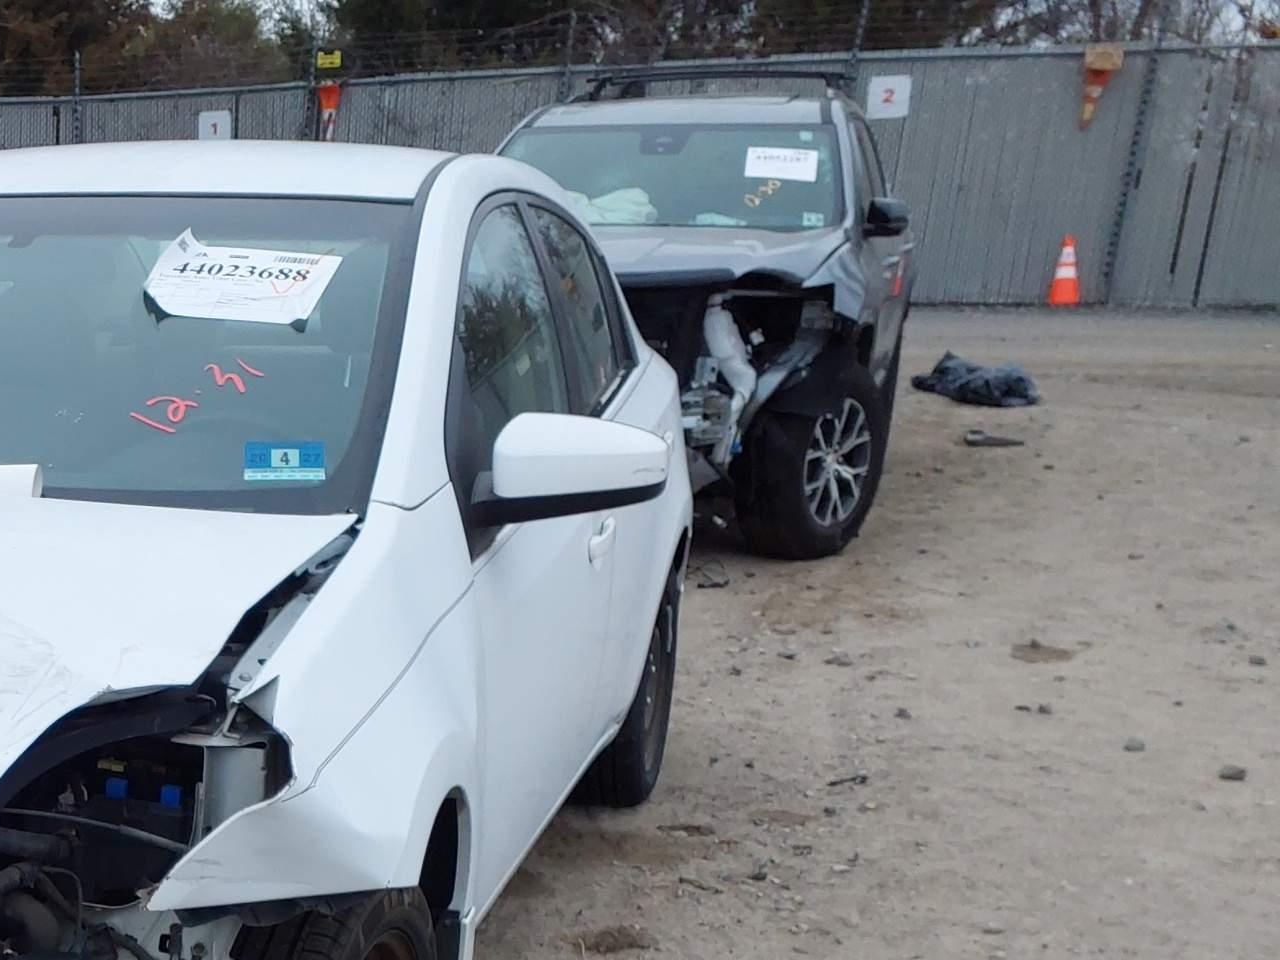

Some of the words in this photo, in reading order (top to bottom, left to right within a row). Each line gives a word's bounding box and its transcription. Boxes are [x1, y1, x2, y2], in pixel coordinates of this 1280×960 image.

[882, 88, 895, 104] 2
[210, 122, 218, 135] 1
[172, 261, 312, 283] 44023688
[279, 451, 291, 466] 4
